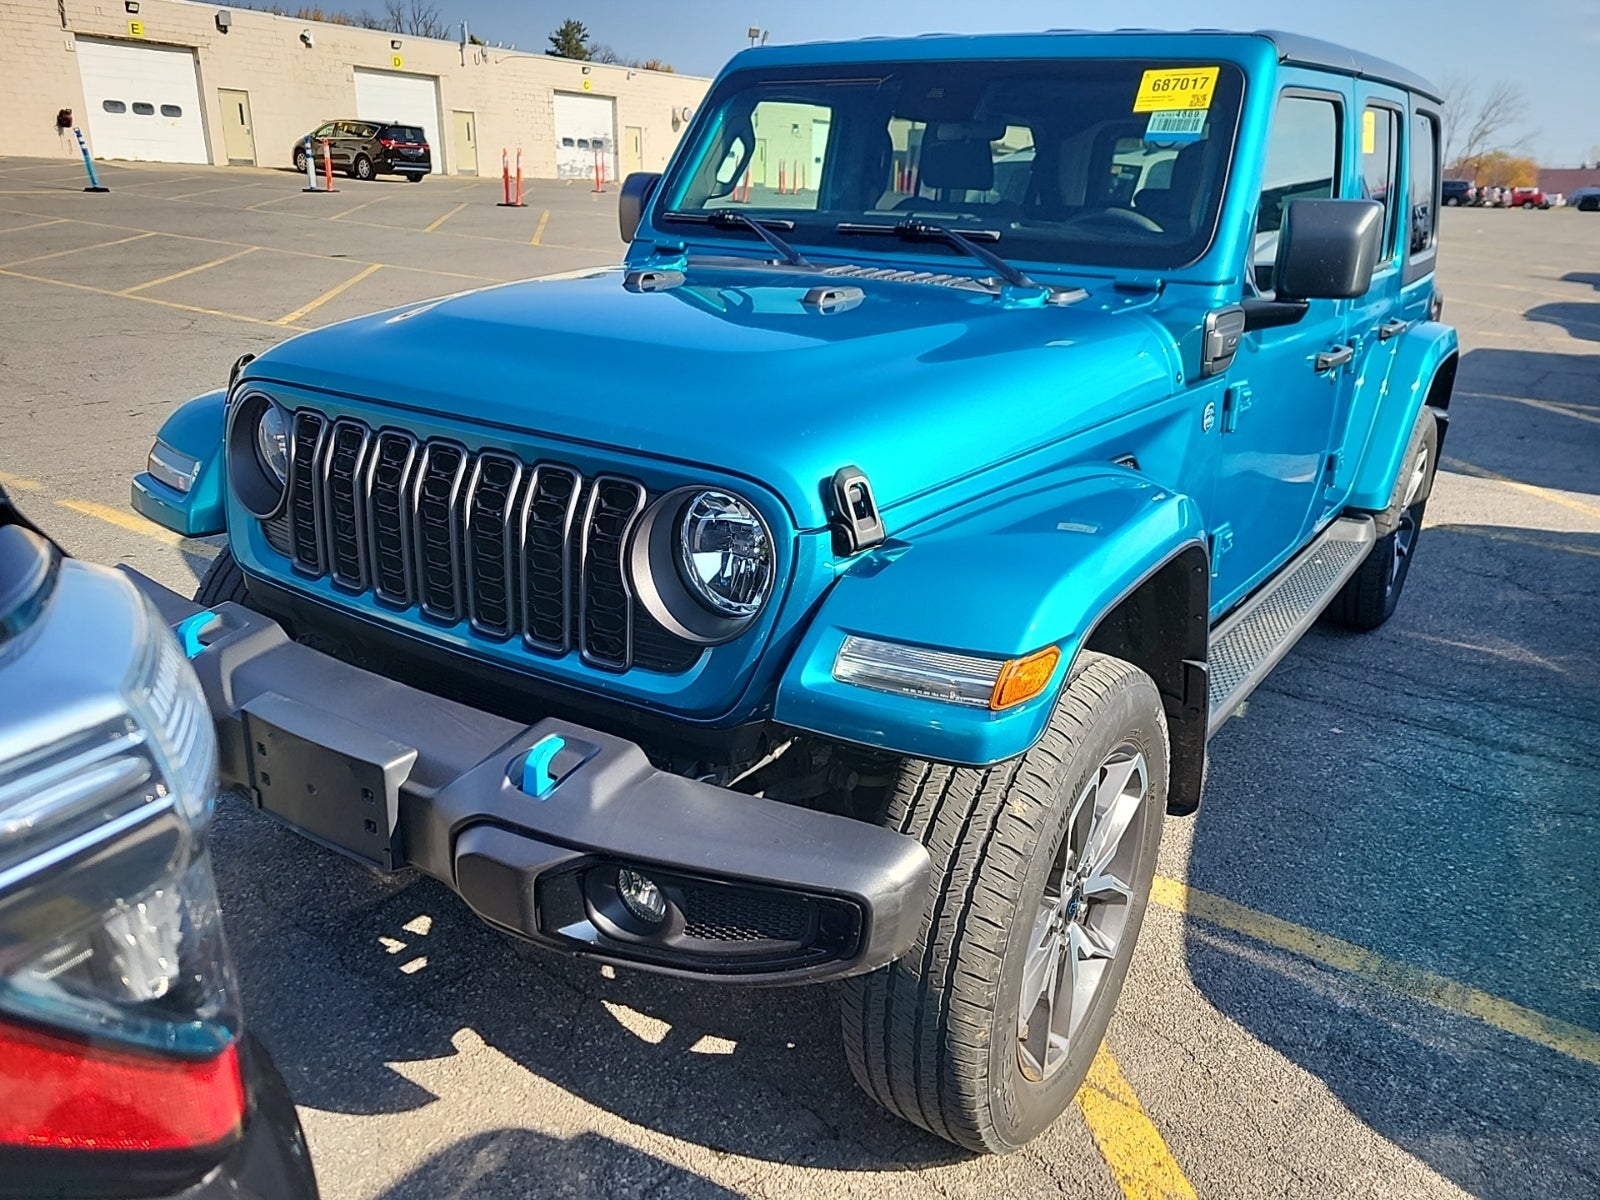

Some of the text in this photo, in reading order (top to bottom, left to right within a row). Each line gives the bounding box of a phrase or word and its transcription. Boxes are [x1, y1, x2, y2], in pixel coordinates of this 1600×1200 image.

[131, 23, 141, 35] E
[393, 57, 401, 67] D
[583, 81, 590, 90] C
[1152, 76, 1209, 92] 687017
[1048, 768, 1086, 860] All-Weather
